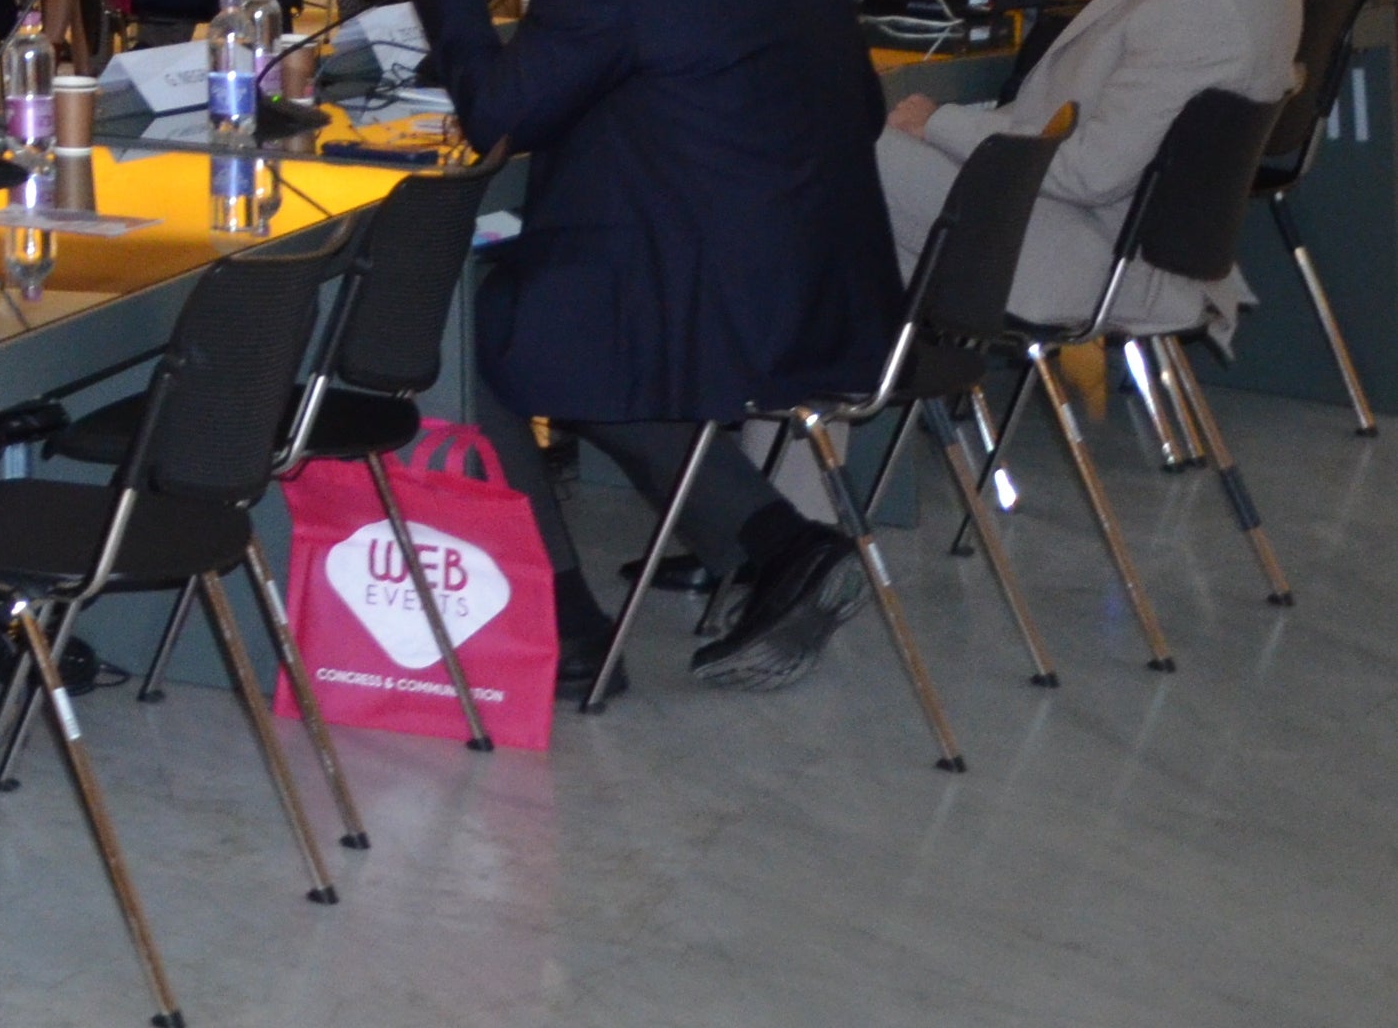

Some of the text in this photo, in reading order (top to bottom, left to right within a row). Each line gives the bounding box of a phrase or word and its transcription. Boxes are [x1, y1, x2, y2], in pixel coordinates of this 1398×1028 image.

[368, 538, 469, 592] WEB
[365, 583, 470, 618] EVETS
[316, 667, 384, 688] CONGRESS
[396, 678, 506, 703] COMMUNITION
